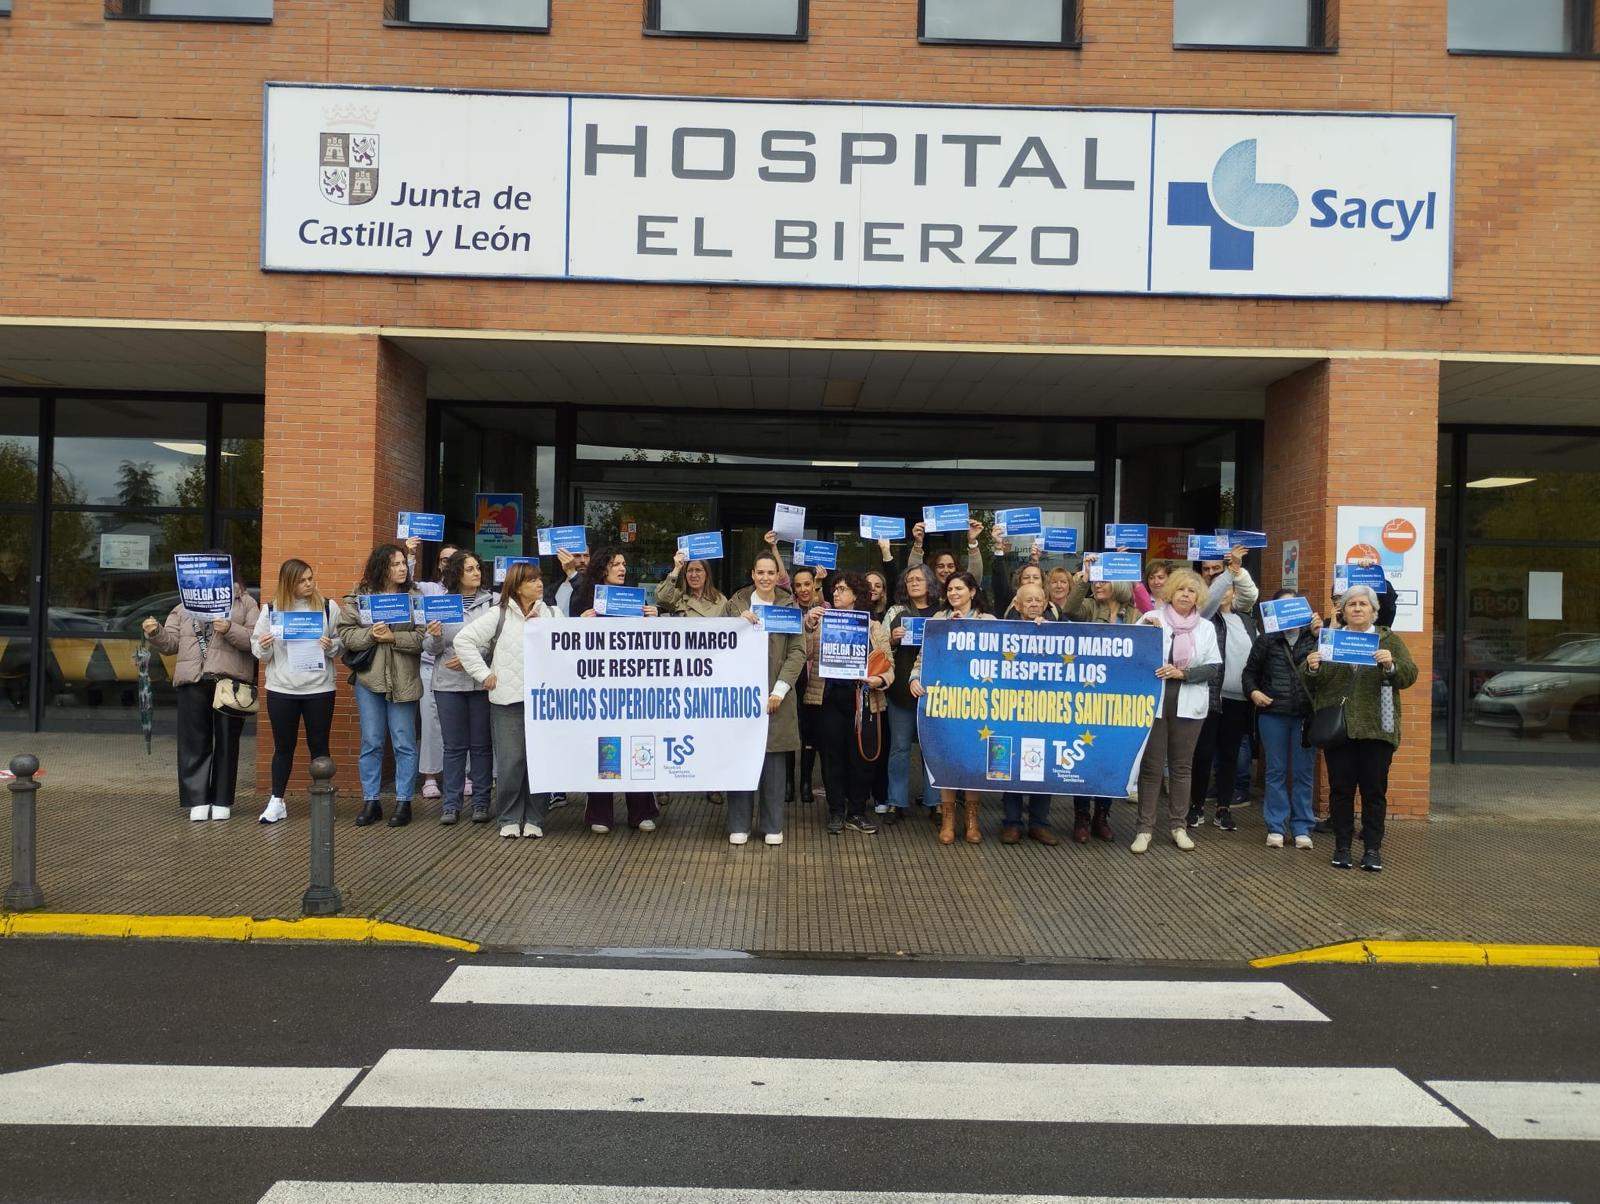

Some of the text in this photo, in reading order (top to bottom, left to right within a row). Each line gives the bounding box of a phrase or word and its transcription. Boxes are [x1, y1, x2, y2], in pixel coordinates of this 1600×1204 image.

[584, 123, 1135, 191] HOSPITAL
[390, 181, 532, 211] Junta de
[1309, 188, 1437, 242] Sacyl
[298, 218, 532, 256] Castilla y León
[636, 214, 1079, 267] EL BIERZO
[182, 587, 231, 601] HUELGA TSS
[551, 631, 738, 651] POR UN ESTATUTO MARCO
[822, 642, 866, 657] HUELGA TSS
[947, 631, 977, 651] POR
[978, 632, 999, 653] UN
[1002, 634, 1076, 656] ESTATUTO
[1077, 636, 1133, 658] MARCO
[576, 658, 713, 680] QUE RESPETE A LOS
[969, 658, 1107, 684] QUE RESPETE A LOS
[531, 682, 761, 721] TÉCNICOS SUPERIORES SANITARIOS
[925, 681, 1155, 728] TÉCNICOS SUPERIORES SANITARIOS
[663, 734, 695, 766] TSS
[1052, 739, 1085, 770] TSS
